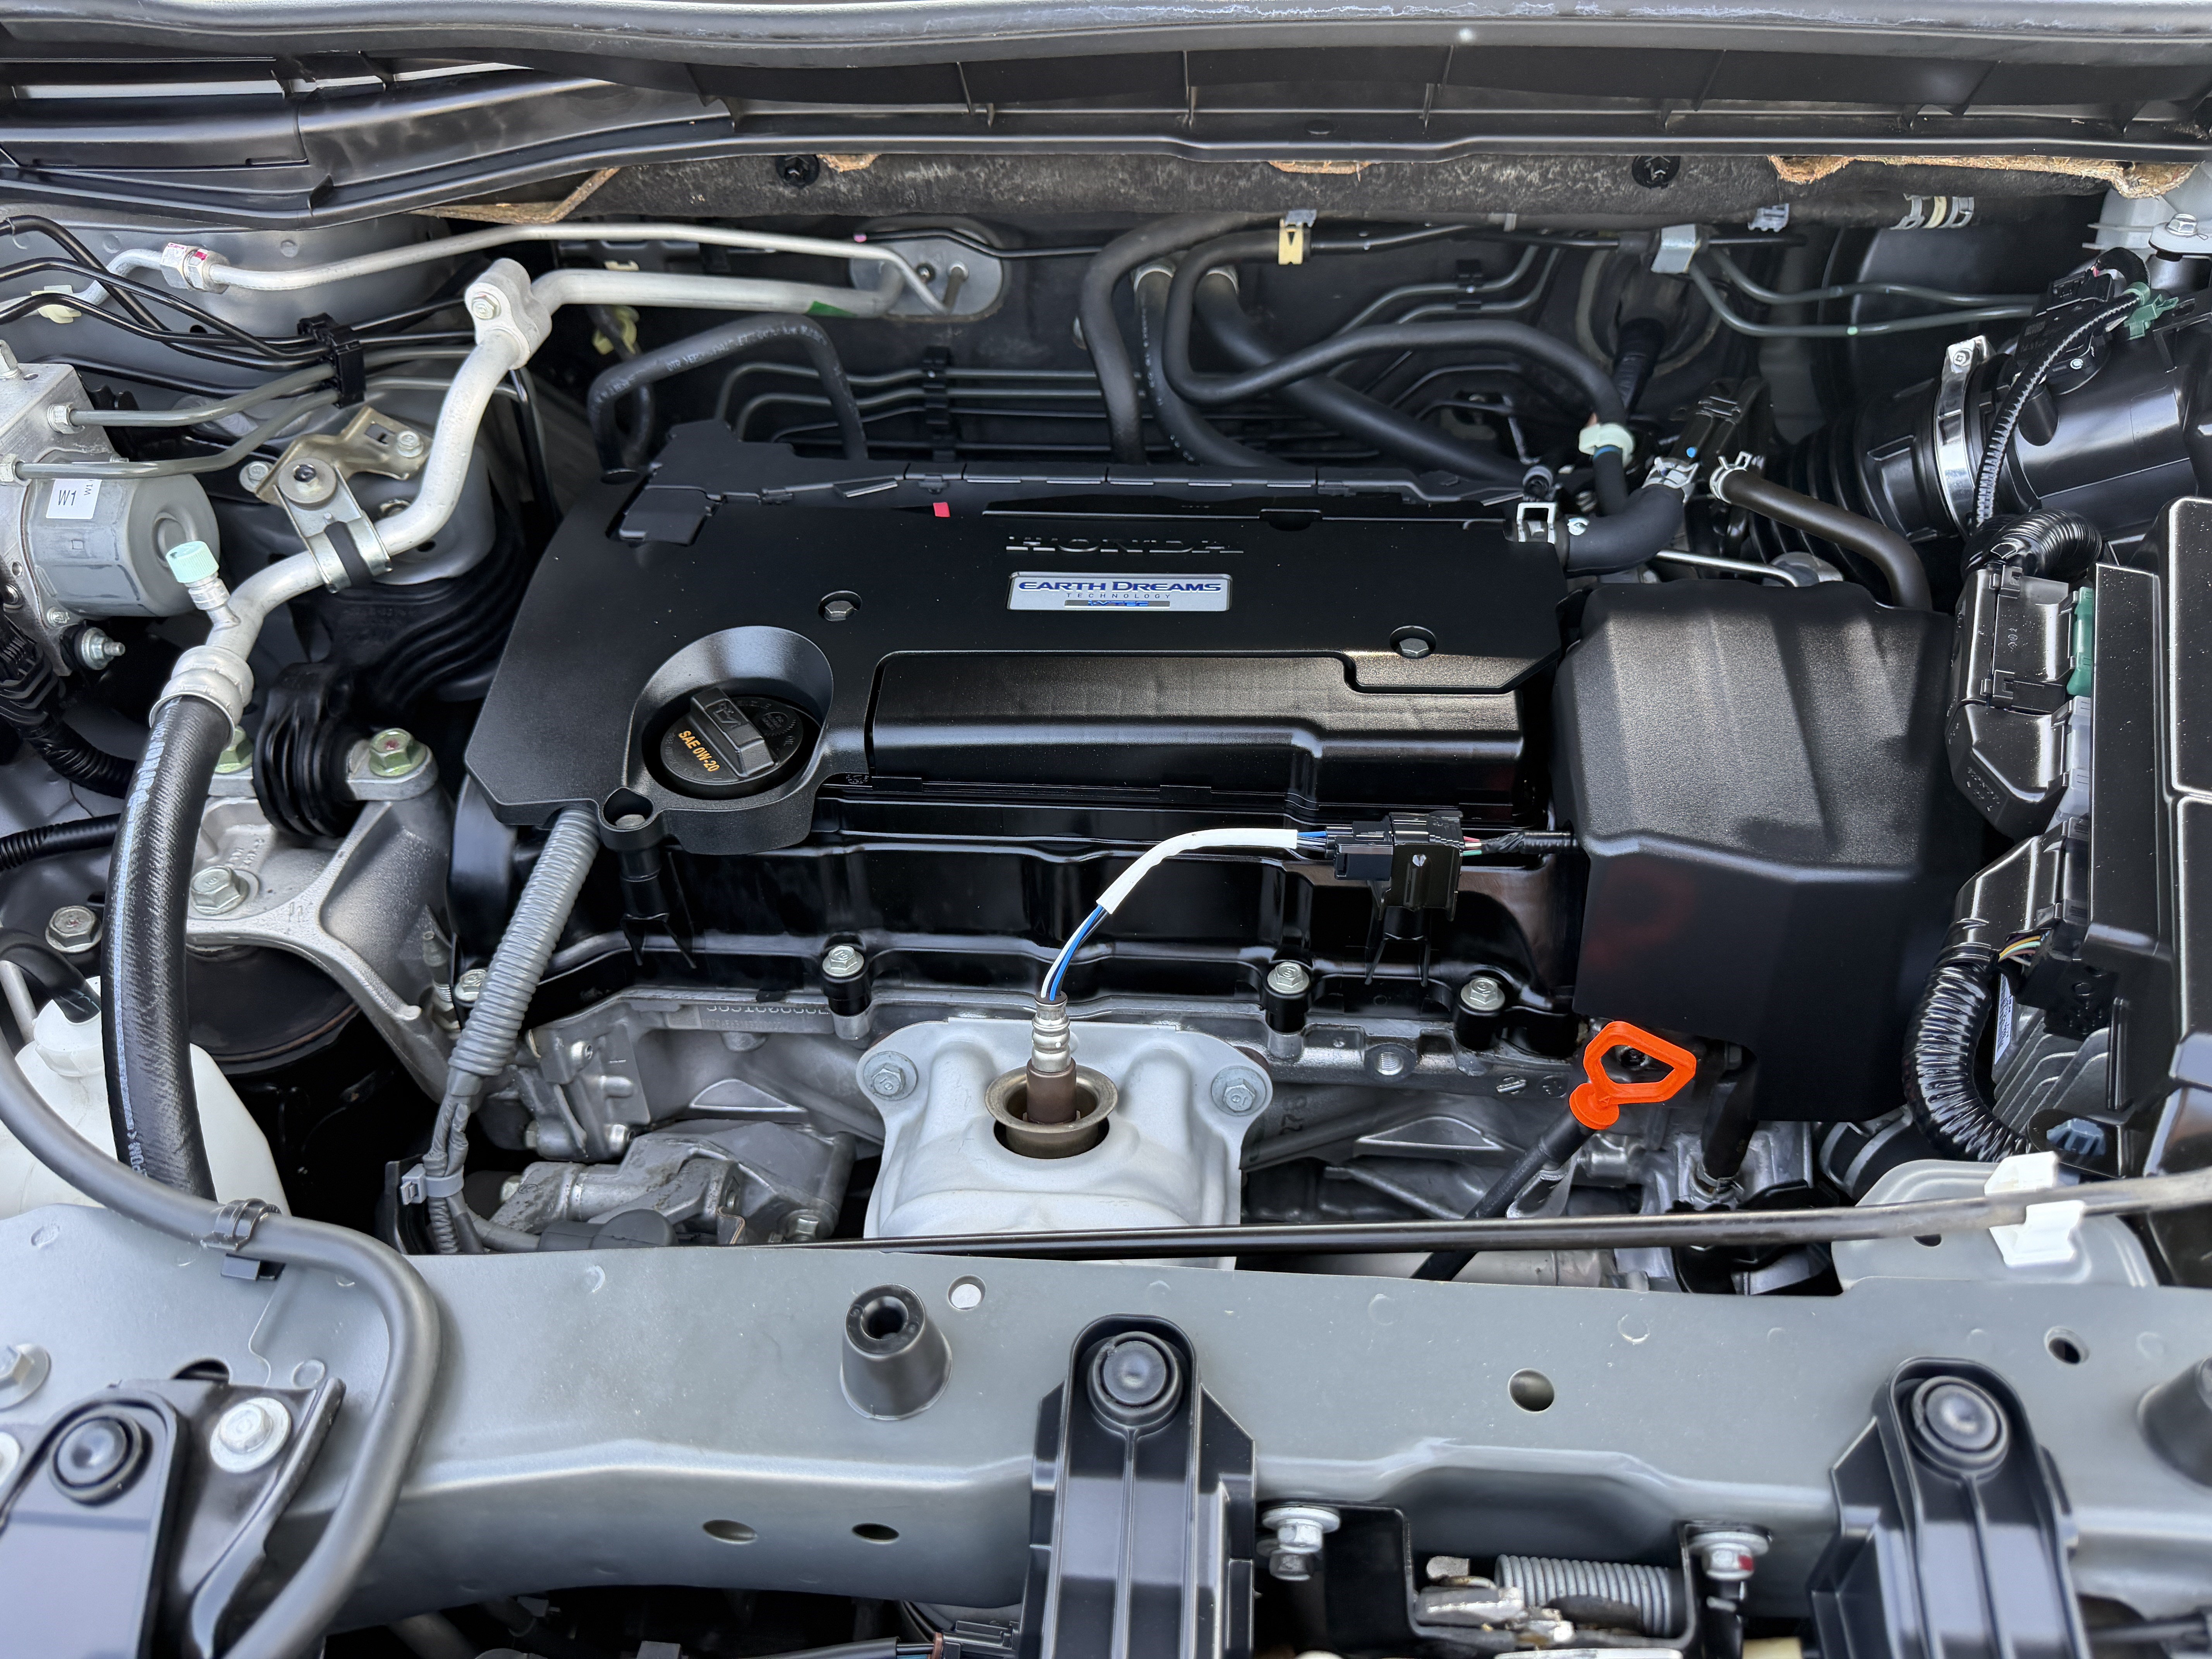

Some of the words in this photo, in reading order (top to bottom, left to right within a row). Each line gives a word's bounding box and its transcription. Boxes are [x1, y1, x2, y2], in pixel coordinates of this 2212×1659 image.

[84, 484, 93, 495] W1
[58, 490, 77, 506] W1
[1006, 537, 1243, 553] HONDA
[1019, 582, 1106, 592] EARTH
[1112, 581, 1221, 593] DREAMS
[678, 730, 701, 749] SAE
[692, 747, 720, 772] 0W-20
